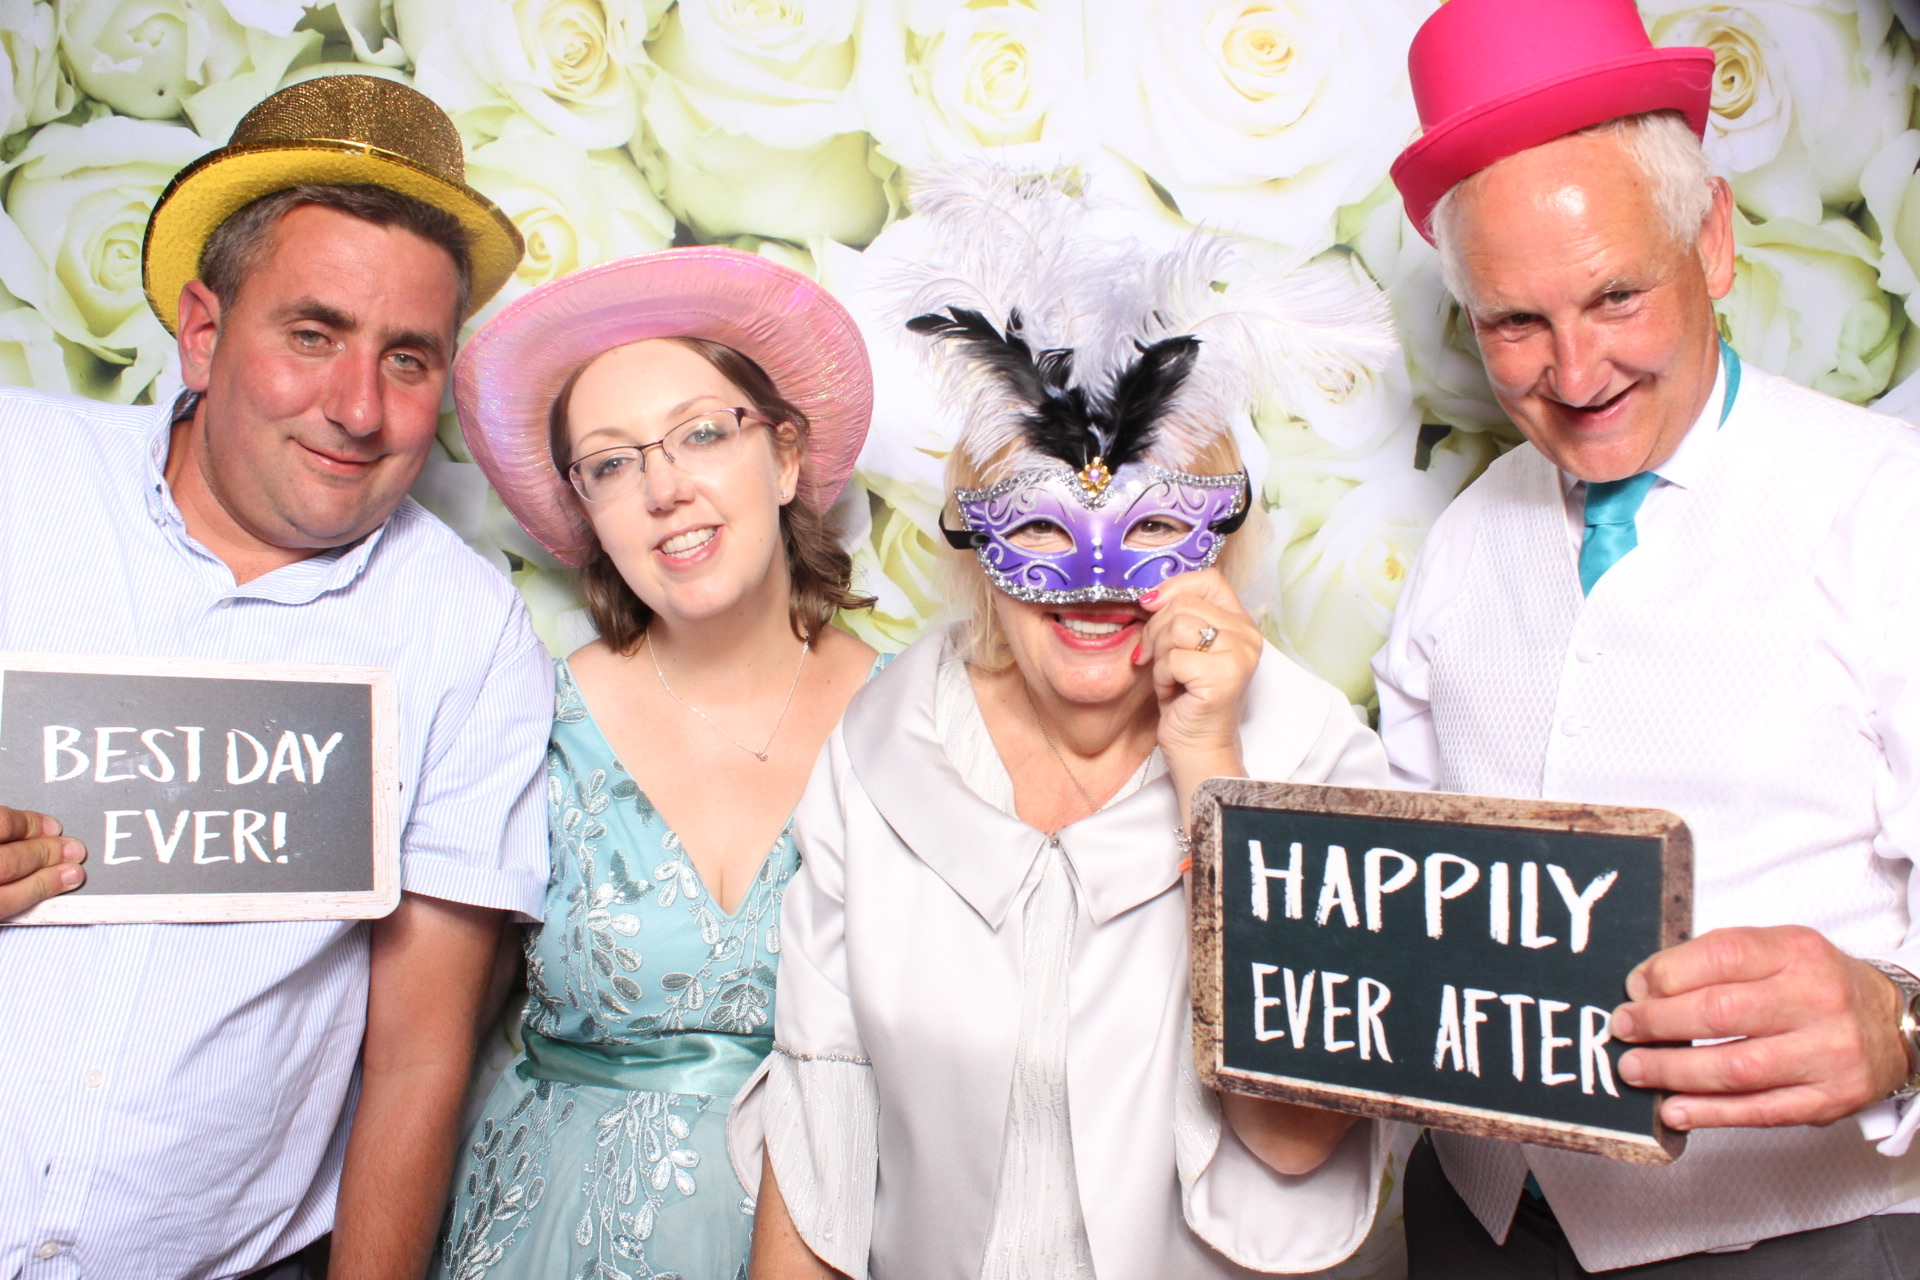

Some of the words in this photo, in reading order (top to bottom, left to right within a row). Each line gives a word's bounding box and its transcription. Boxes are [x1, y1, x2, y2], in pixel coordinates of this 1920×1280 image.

[43, 725, 205, 784] BEST
[226, 729, 345, 785] DAY
[103, 809, 289, 865] EVER!
[1248, 840, 1618, 954] HAPPILY
[1251, 963, 1393, 1063] EVER
[1433, 984, 1620, 1098] AFTER
